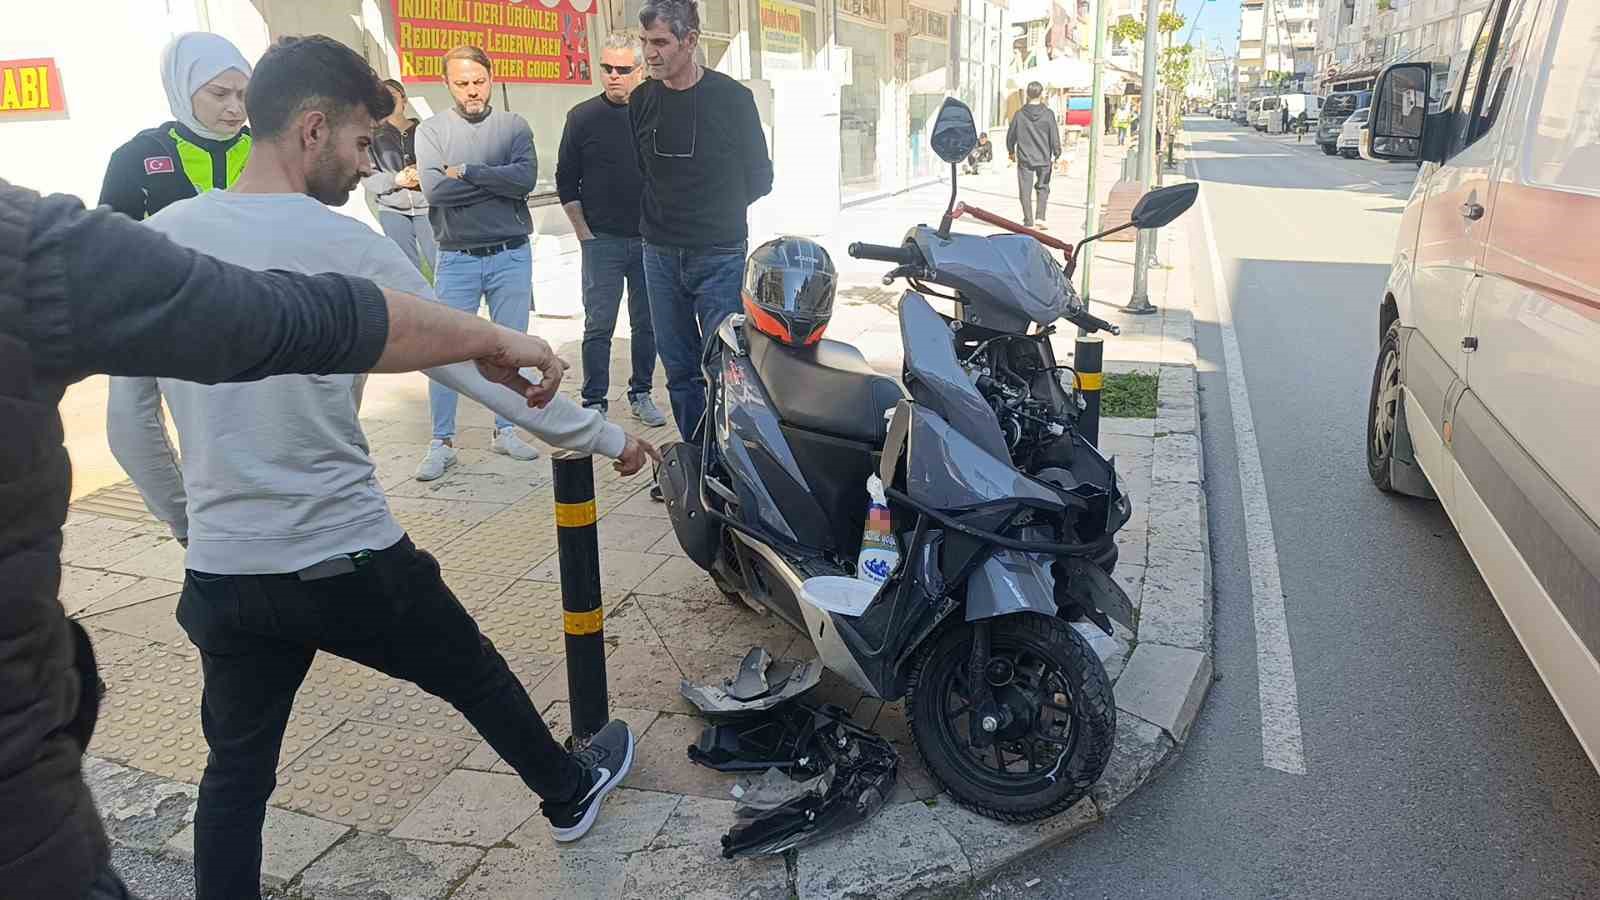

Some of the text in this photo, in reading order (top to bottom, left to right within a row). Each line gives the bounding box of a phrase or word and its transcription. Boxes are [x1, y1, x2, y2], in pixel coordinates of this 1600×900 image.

[506, 3, 559, 32] ÜRÜNLER
[401, 51, 561, 80] REDU THER GOODS
[0, 64, 50, 110] ABI
